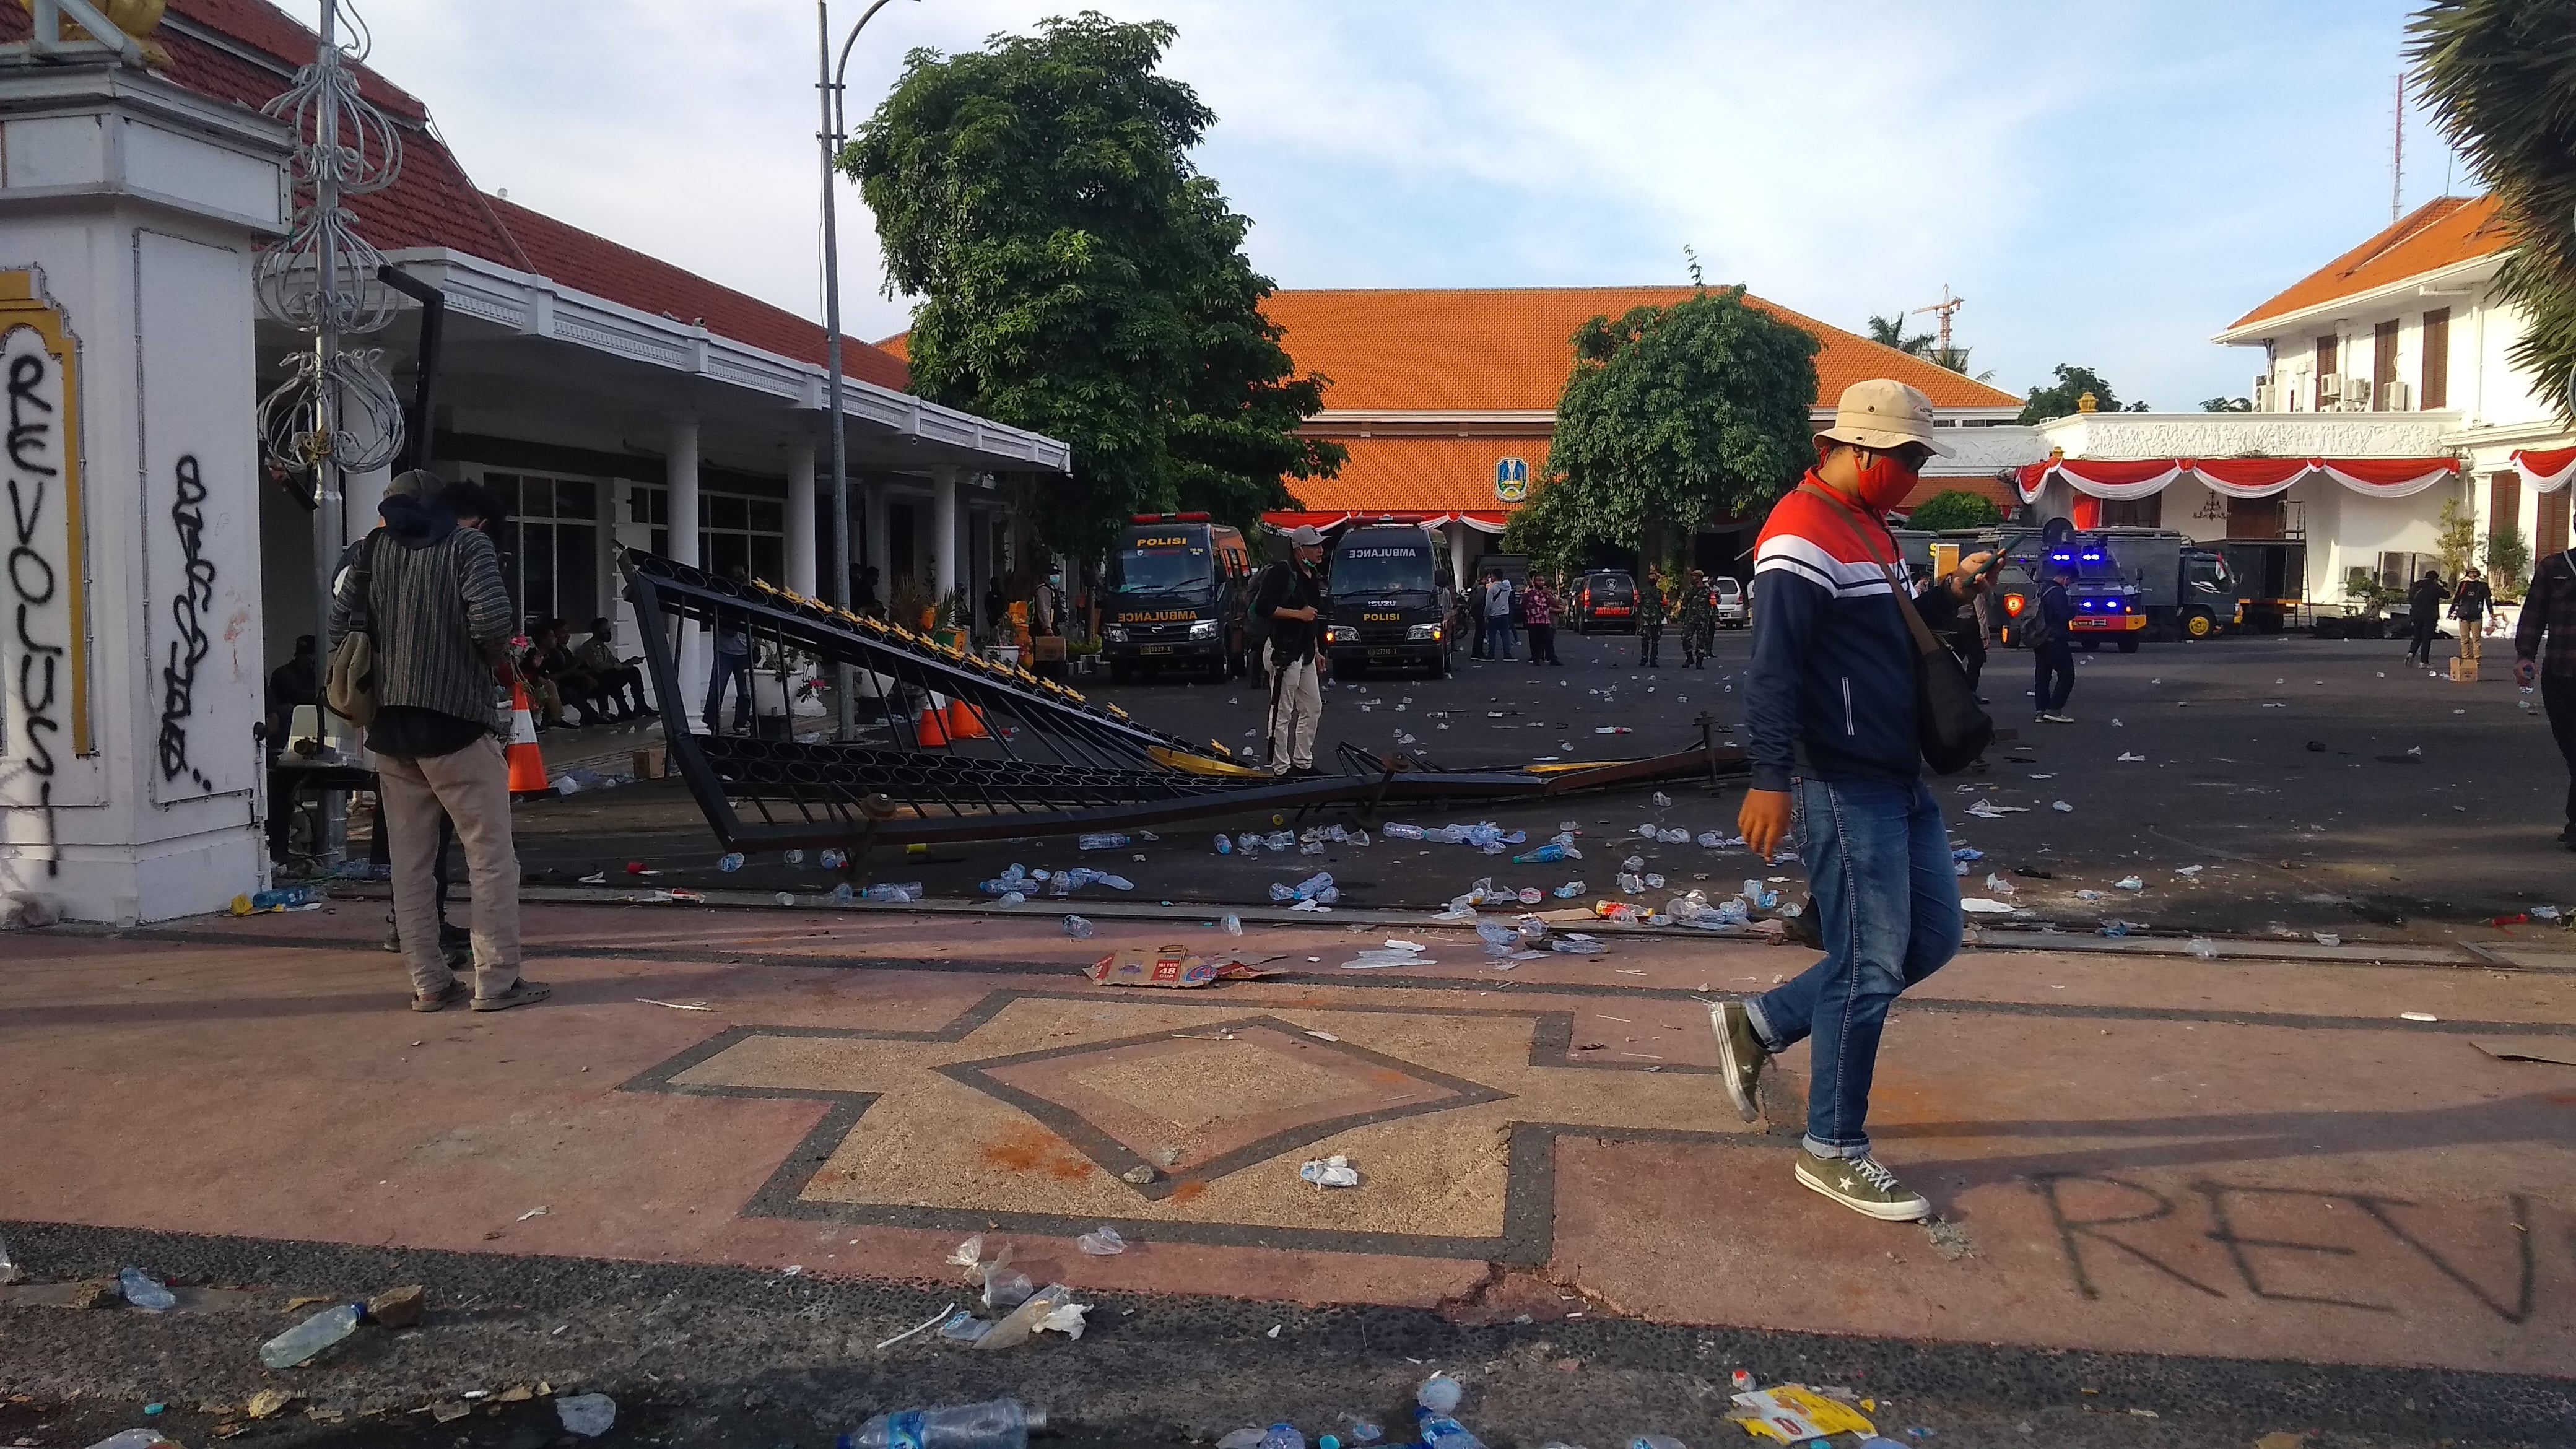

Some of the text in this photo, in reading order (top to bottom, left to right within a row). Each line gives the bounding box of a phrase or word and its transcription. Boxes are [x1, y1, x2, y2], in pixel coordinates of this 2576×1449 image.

[1136, 537, 1187, 547] POLISI
[7, 354, 63, 877] REVOLUSI
[1364, 613, 1401, 622] POLISI
[2026, 1170, 2576, 1325] REV
